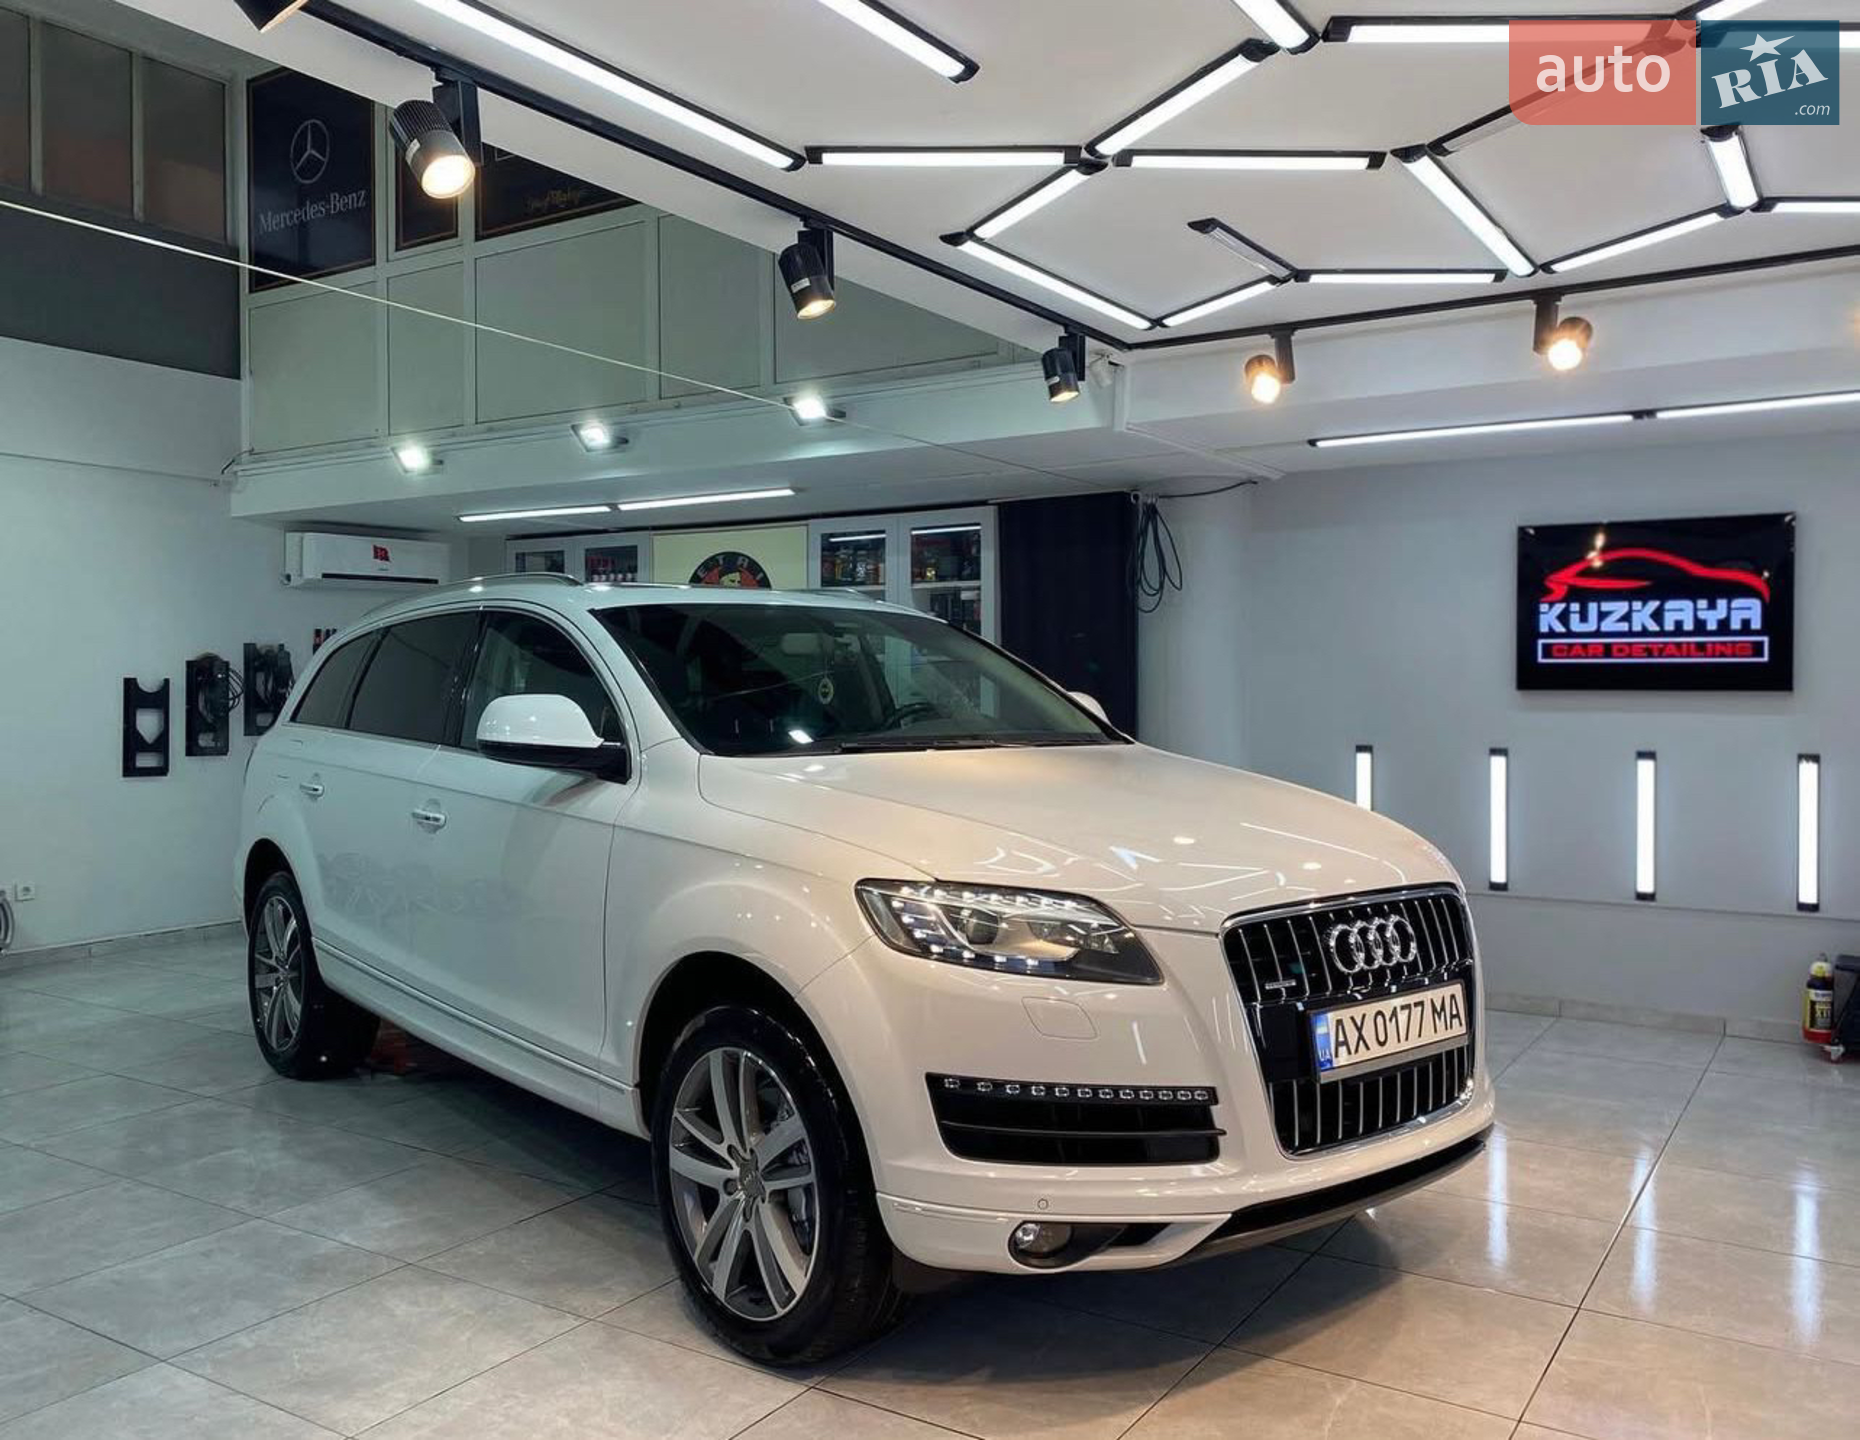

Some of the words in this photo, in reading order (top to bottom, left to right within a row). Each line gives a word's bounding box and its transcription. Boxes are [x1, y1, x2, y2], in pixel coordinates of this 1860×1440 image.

[259, 190, 366, 235] Mercedes-Benz
[1538, 598, 1762, 633] KUZKAYA
[1551, 643, 1605, 658] CAR
[1611, 642, 1754, 658] DETAILING
[1334, 1013, 1370, 1058] AX
[1373, 1001, 1425, 1047] 0177
[1431, 993, 1463, 1034] MA
[1319, 1048, 1332, 1062] UA
